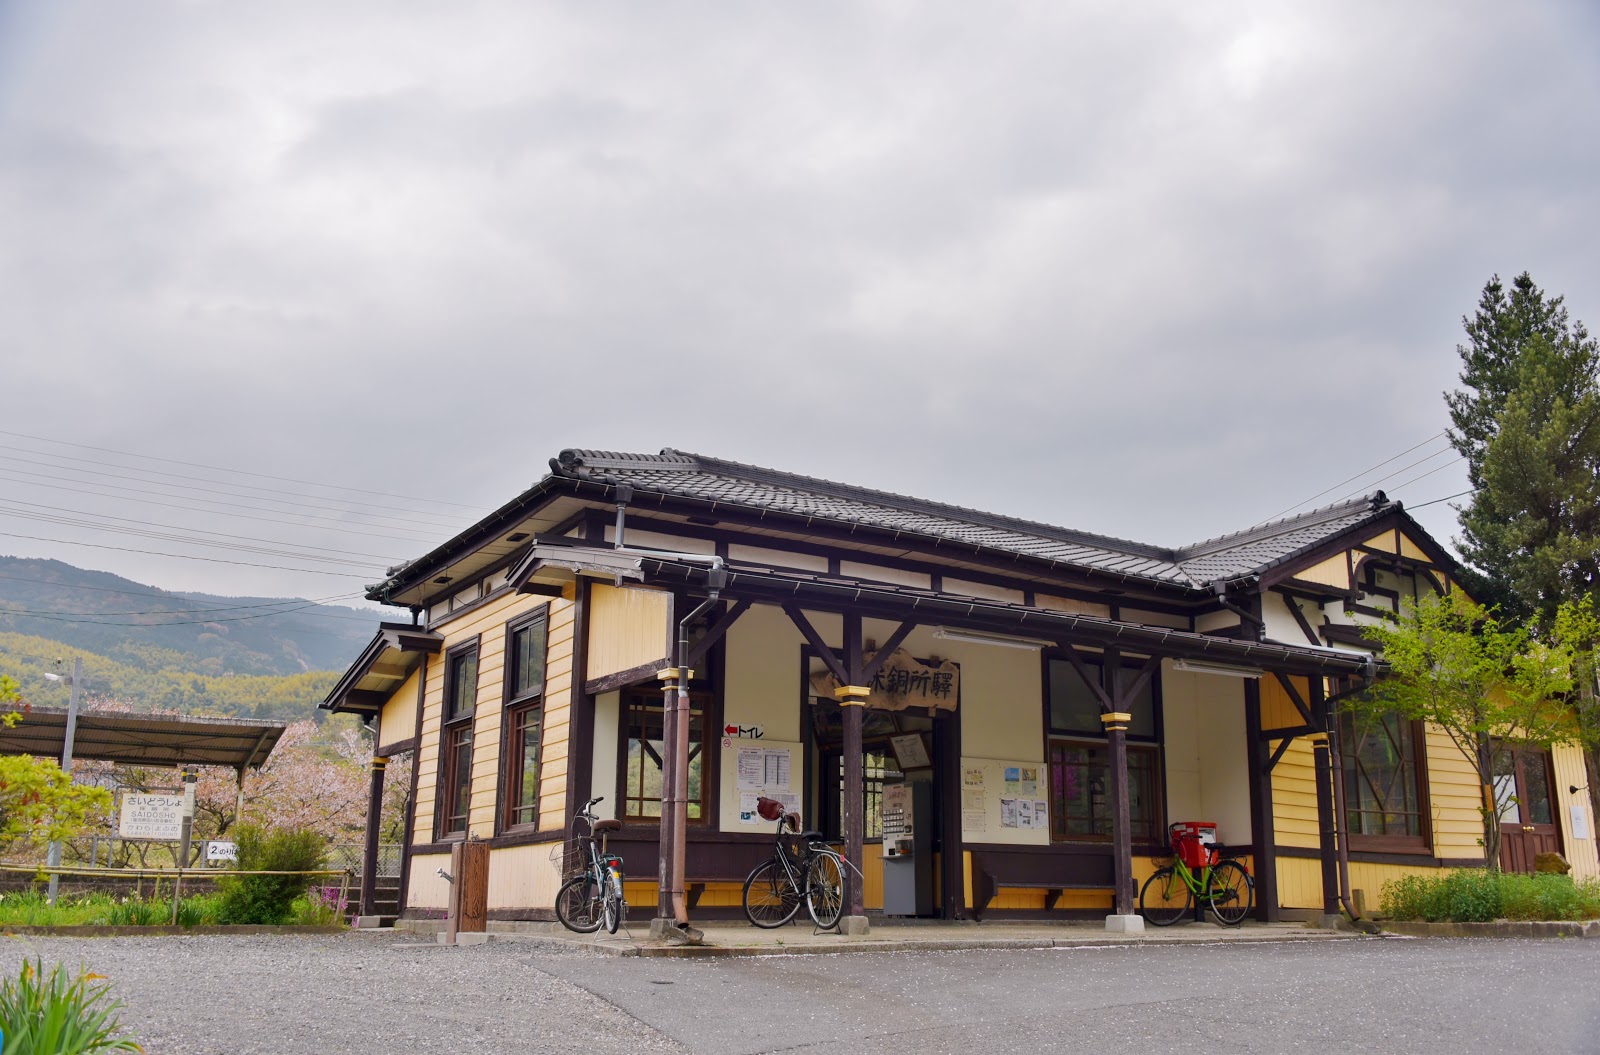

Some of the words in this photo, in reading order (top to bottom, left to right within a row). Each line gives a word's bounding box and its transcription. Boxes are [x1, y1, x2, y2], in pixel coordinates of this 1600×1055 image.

[738, 725, 764, 739] トイレ
[128, 796, 182, 806] さいどうしょ
[131, 811, 176, 819] SAIDOSHO
